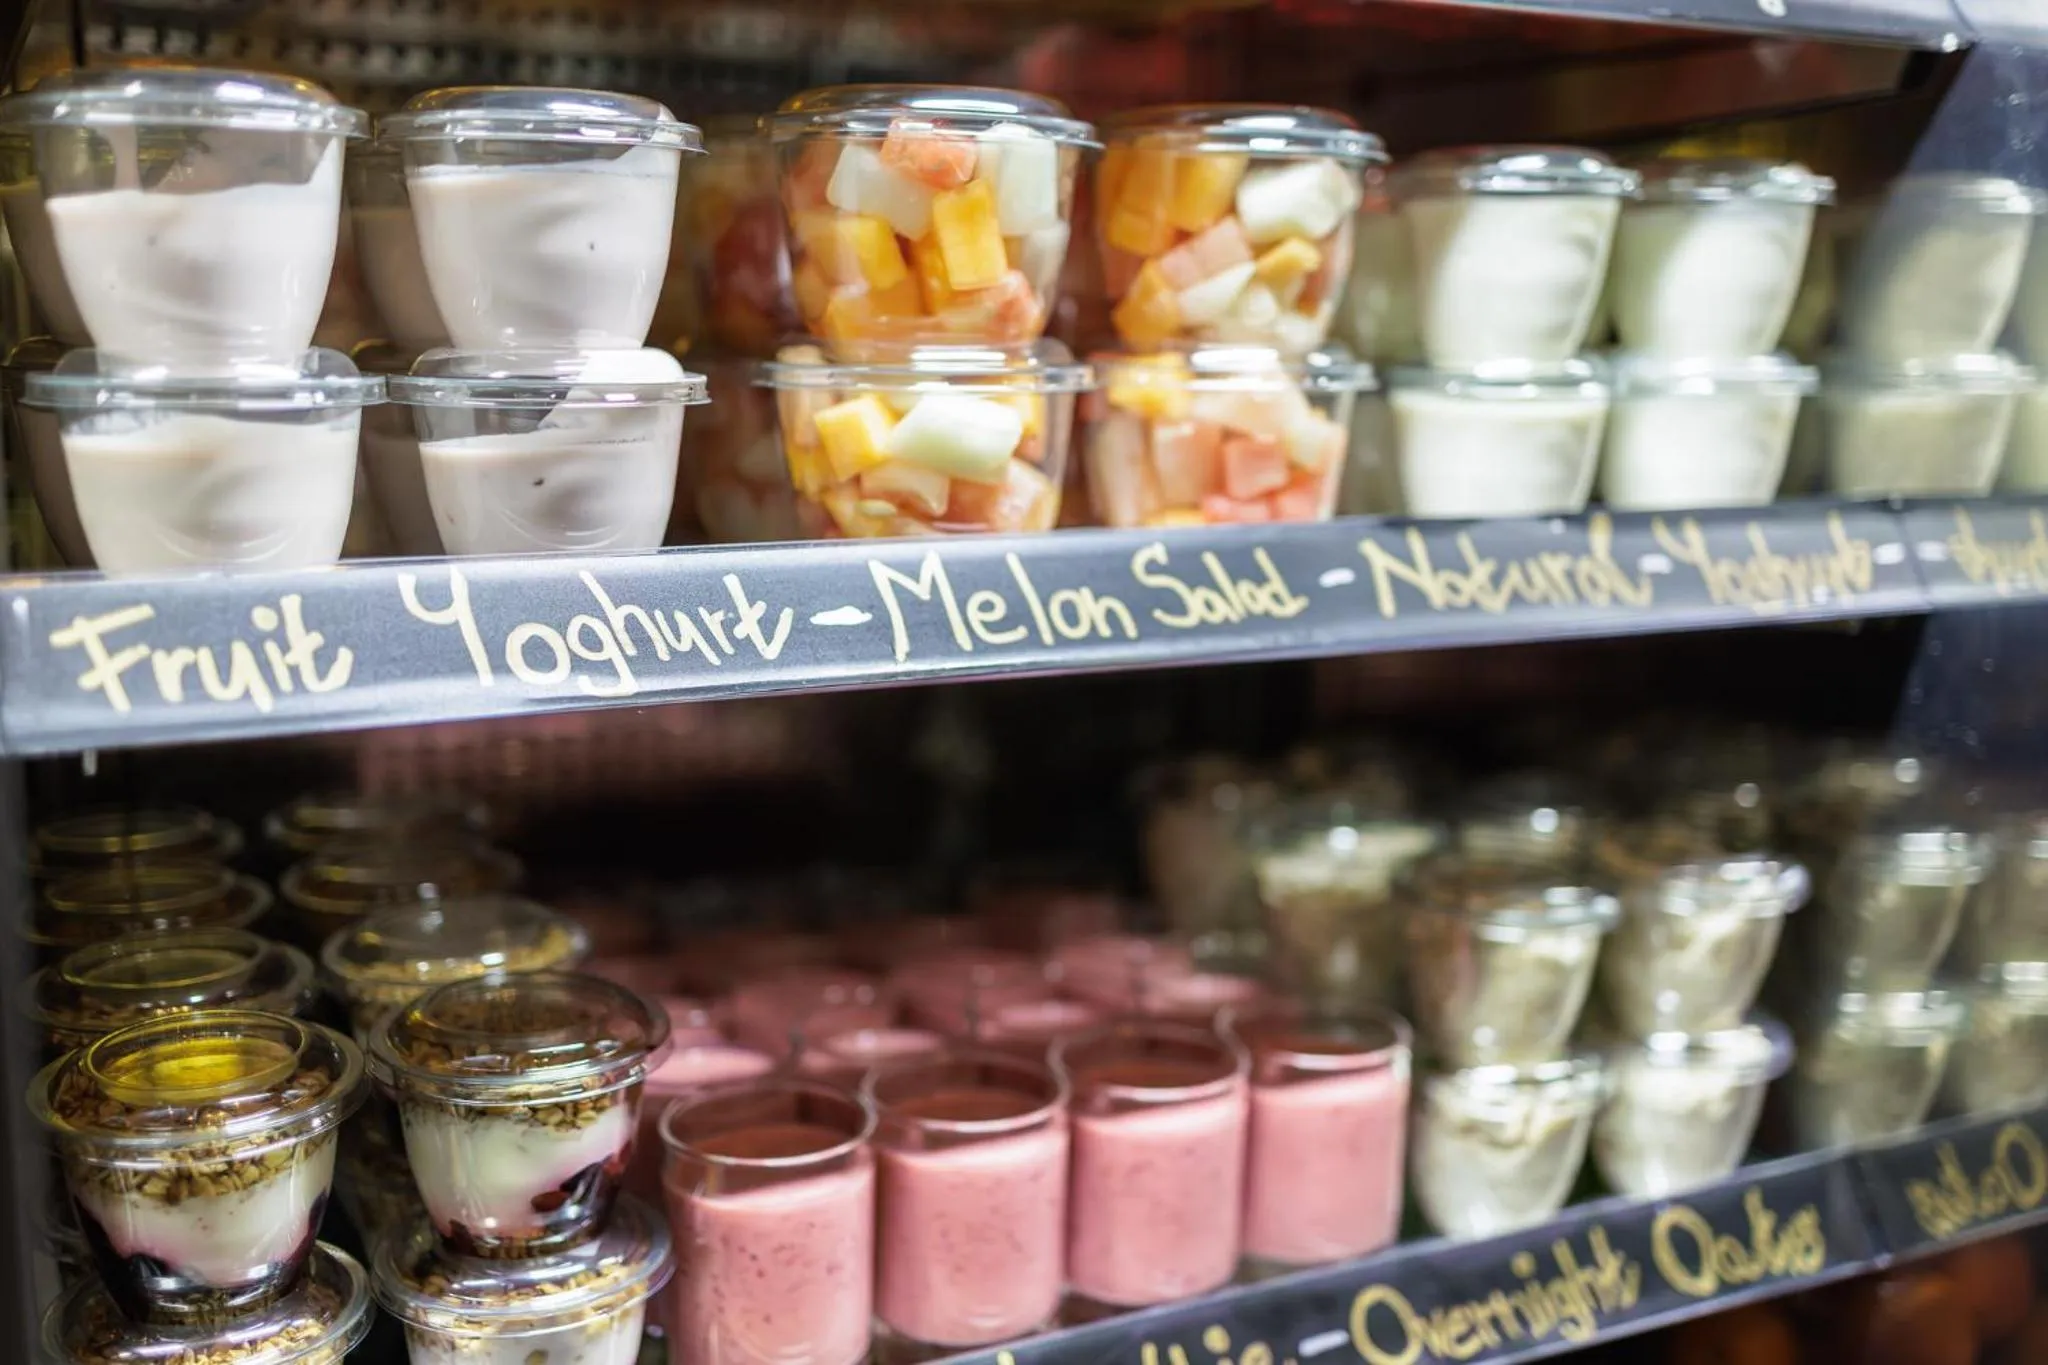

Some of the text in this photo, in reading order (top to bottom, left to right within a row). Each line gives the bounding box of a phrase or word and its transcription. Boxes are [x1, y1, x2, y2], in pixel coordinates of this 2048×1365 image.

[50, 593, 355, 714] Fruit
[397, 564, 796, 699] Yoghurt
[867, 547, 1139, 663] Melon
[1349, 1225, 1642, 1365] Overnight
